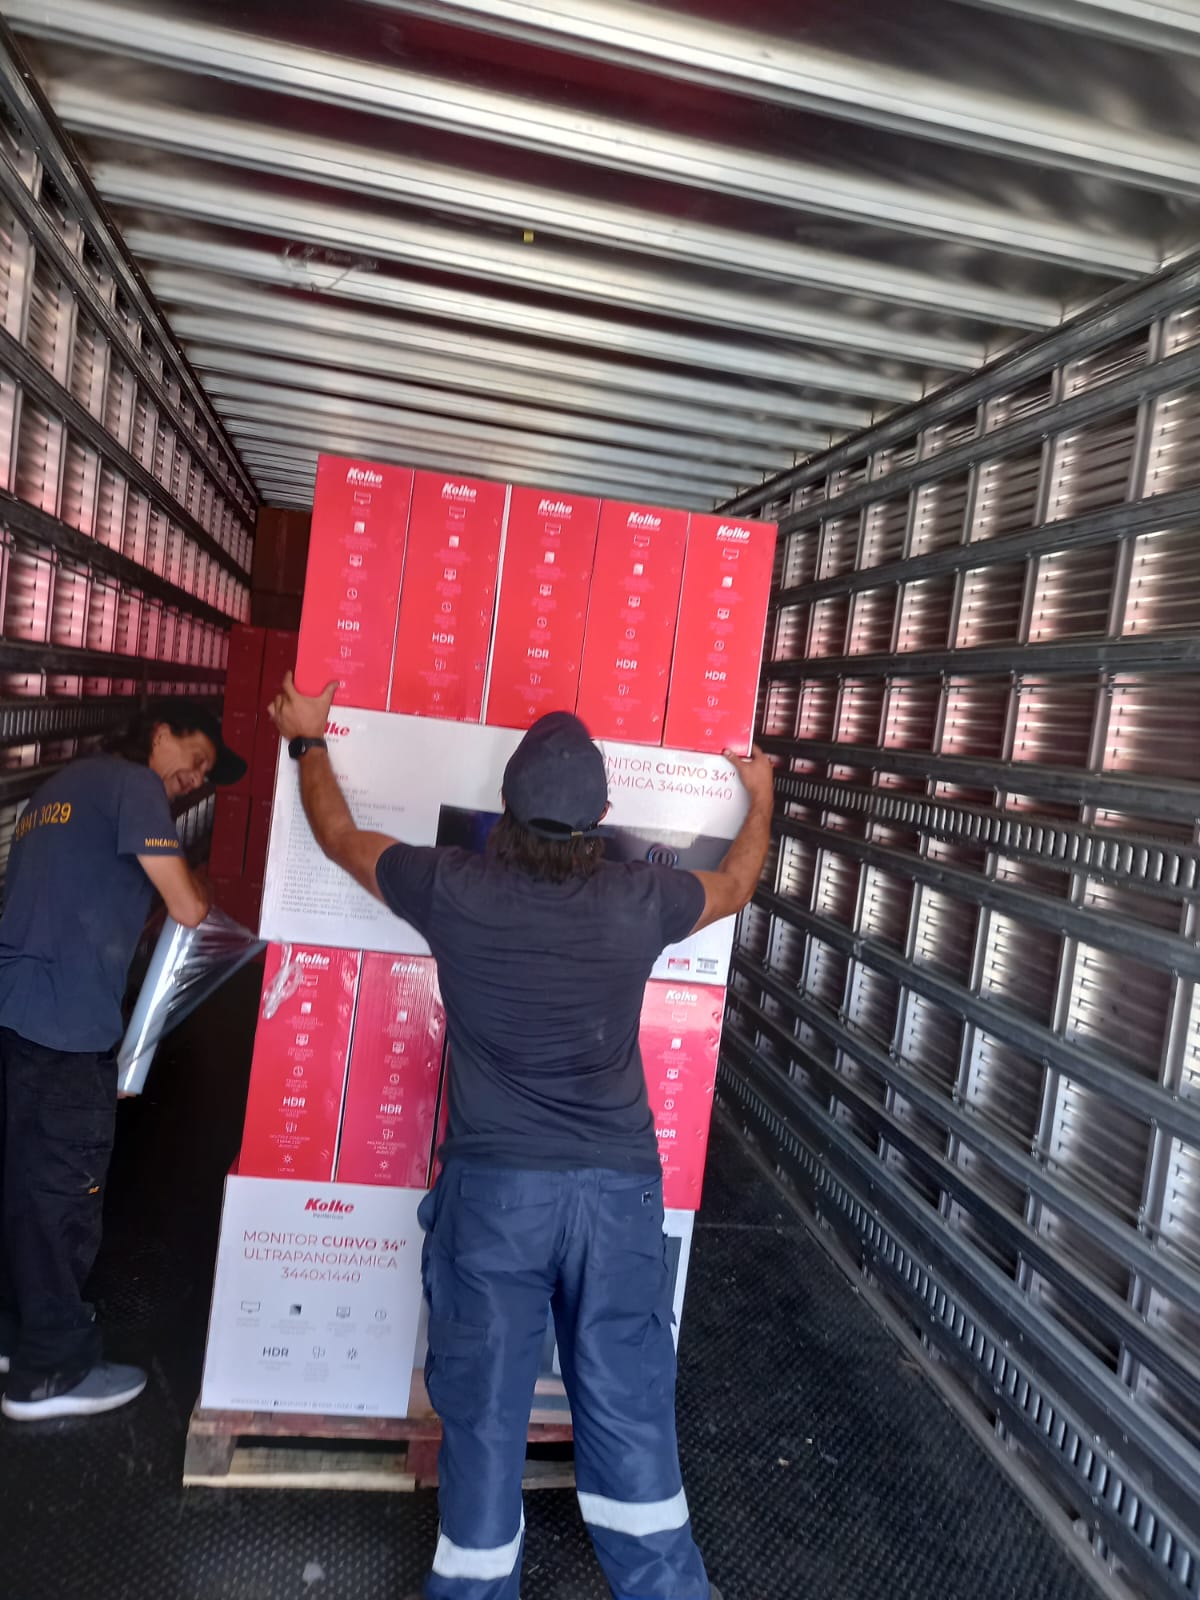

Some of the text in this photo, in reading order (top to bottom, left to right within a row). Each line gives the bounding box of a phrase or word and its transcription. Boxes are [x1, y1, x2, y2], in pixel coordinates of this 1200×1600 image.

[347, 468, 383, 483] Kolke
[442, 483, 477, 497] Kolke
[538, 499, 572, 514] Kolke
[627, 512, 661, 527] Kolke
[717, 525, 750, 540] Kolke
[337, 619, 360, 631] HDR
[432, 633, 454, 645] HDR
[527, 648, 549, 659] HDR
[616, 659, 637, 670] HDR
[705, 670, 726, 682] HDR
[324, 722, 350, 736] lke
[606, 756, 652, 773] NITOR
[656, 762, 708, 779] CURVO
[658, 780, 733, 800] 3440x1440
[295, 952, 330, 966] Kolke
[391, 962, 425, 975] Kolke
[665, 990, 698, 1003] Kolke
[282, 1096, 306, 1107] HDR
[380, 1103, 402, 1114] HDR
[656, 1128, 676, 1139] HDR
[304, 1198, 354, 1213] Kolke
[243, 1230, 407, 1251] MONITOR CURVO 34"
[281, 1266, 361, 1283] 3440x1440
[263, 1346, 289, 1357] HDR
